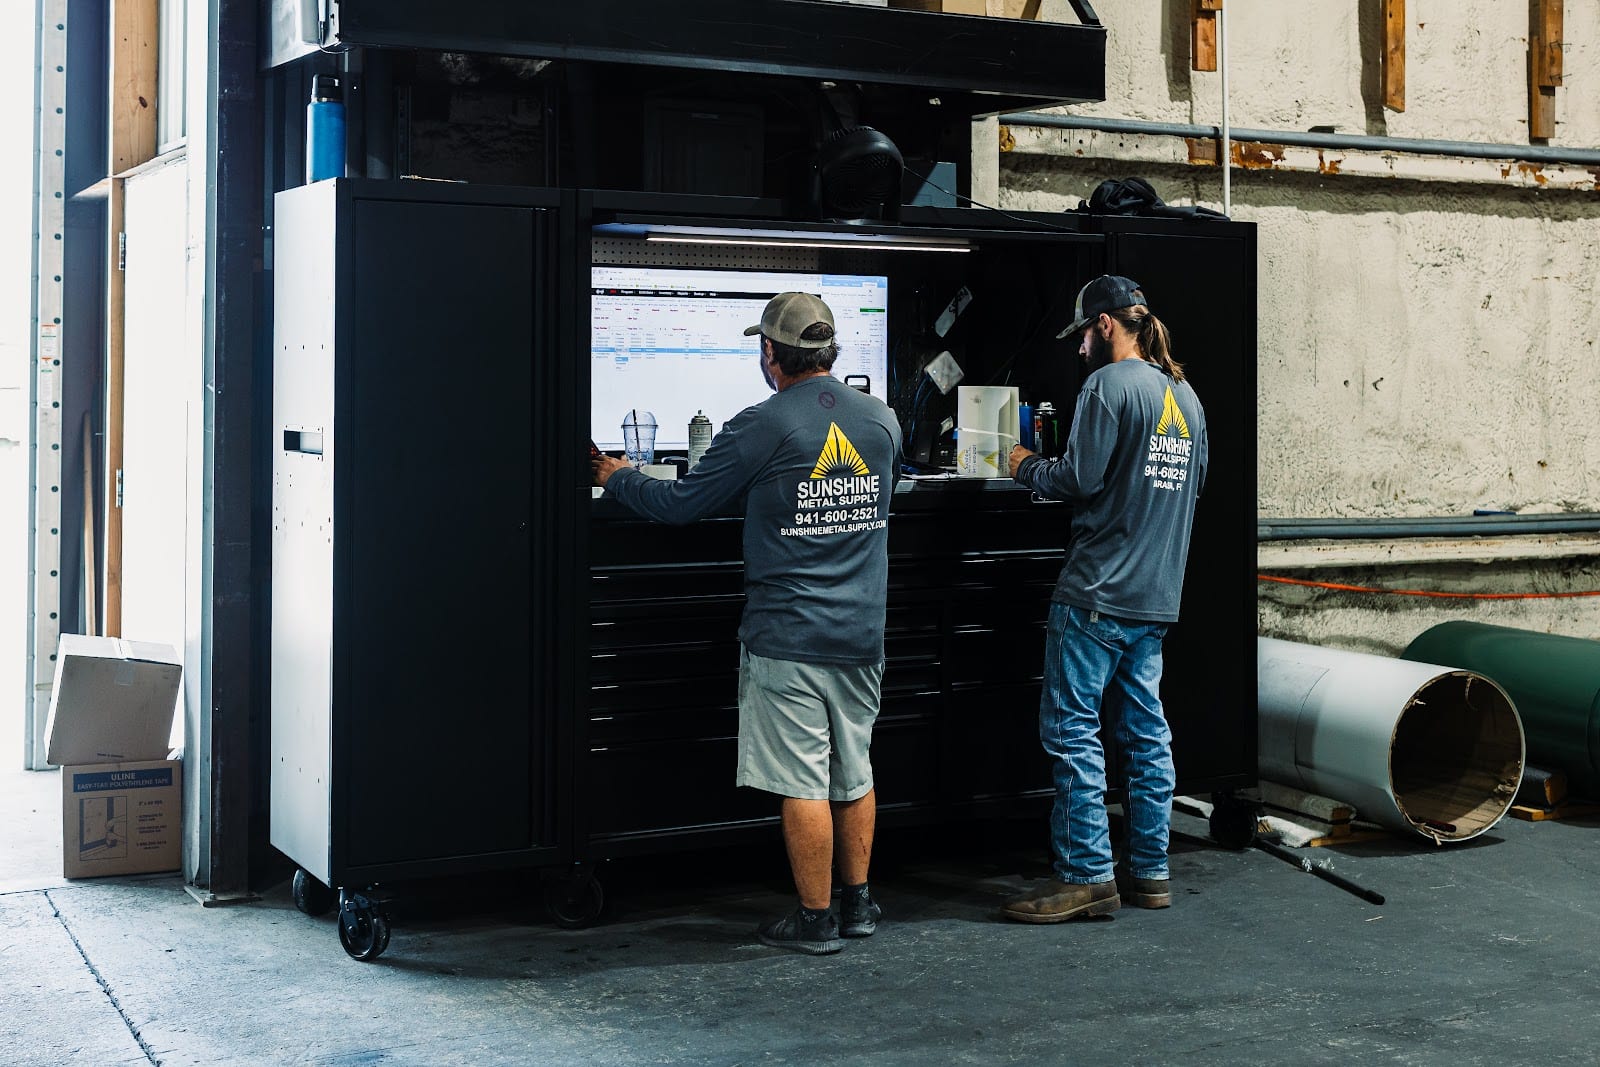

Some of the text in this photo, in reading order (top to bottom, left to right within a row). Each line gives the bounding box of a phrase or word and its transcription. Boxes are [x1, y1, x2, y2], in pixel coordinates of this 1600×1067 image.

[797, 475, 880, 499] SUNSHINE
[797, 493, 880, 509] METAL SUPPLY
[795, 505, 878, 525] 941-600-2521
[780, 520, 886, 536] SUNSHINEMETALSUPPLY.COM
[111, 772, 136, 781] ULINE
